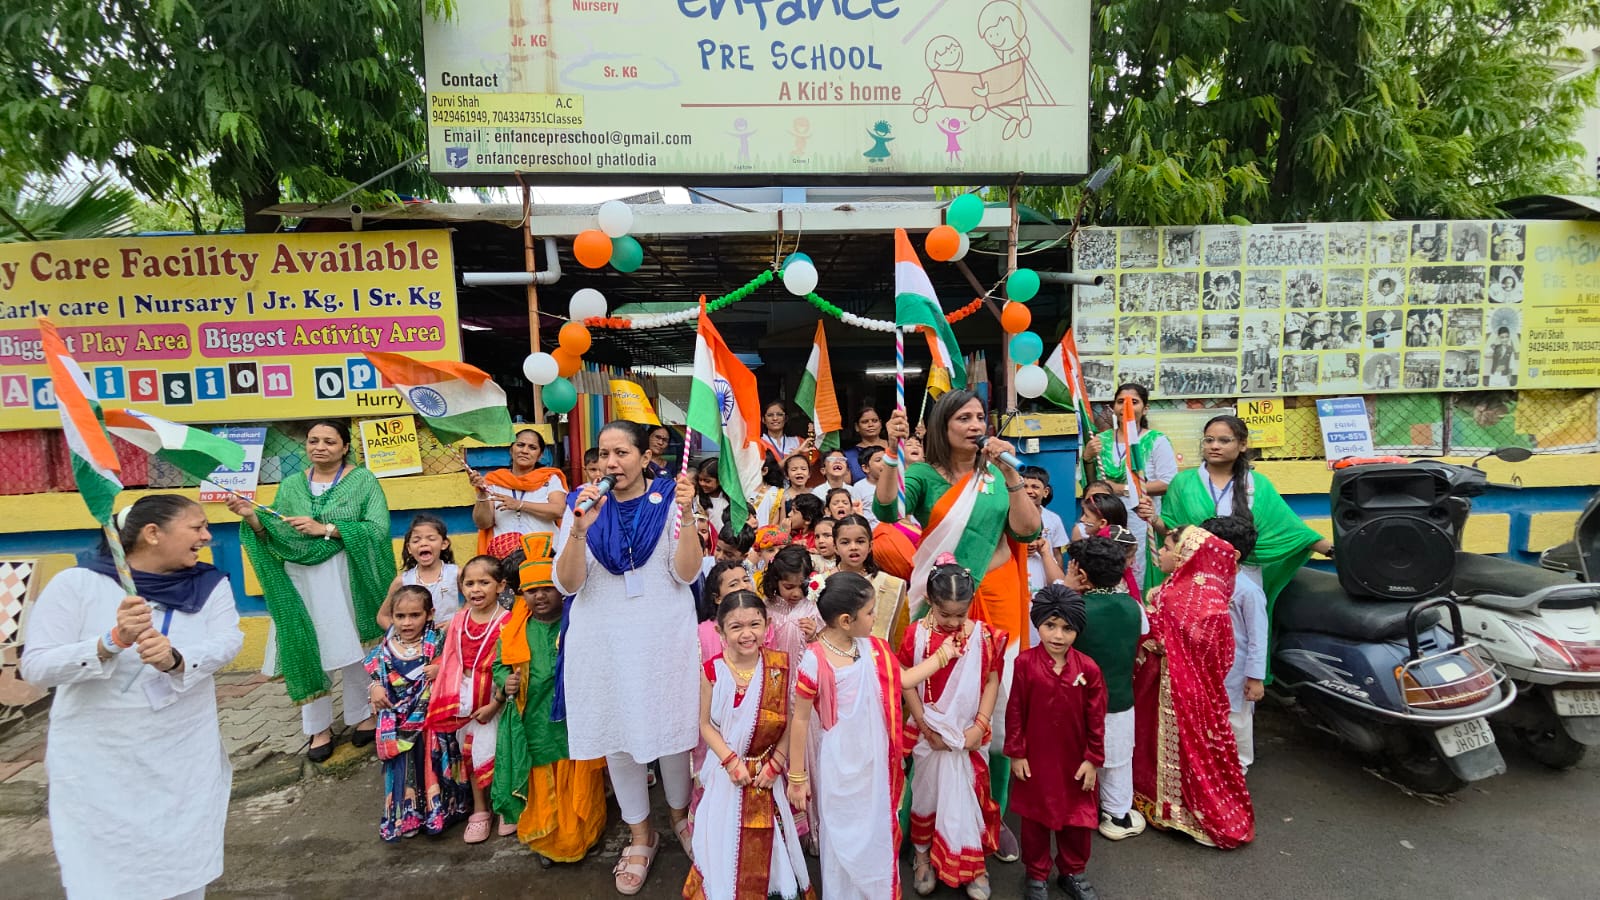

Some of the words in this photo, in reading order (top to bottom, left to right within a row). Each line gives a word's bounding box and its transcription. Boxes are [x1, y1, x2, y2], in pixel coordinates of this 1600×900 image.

[572, 0, 619, 15] Nursery
[511, 34, 526, 47] Jr.
[530, 34, 547, 47] KG
[697, 39, 754, 71] PRE
[771, 40, 882, 71] SCHOOL
[441, 71, 498, 88] Contact
[603, 65, 619, 78] Sr.
[622, 65, 638, 78] KG
[778, 81, 791, 101] A
[798, 80, 843, 101] Kid's
[850, 81, 901, 101] home
[431, 95, 456, 108] Purvi
[457, 94, 480, 108] Shah
[555, 98, 573, 109] A.C
[547, 113, 582, 124] Classes
[444, 129, 481, 143] Email
[494, 130, 693, 146] enfancepreschool@gmail.com
[476, 152, 592, 167] enfancepreschool
[596, 152, 657, 168] ghatlodia
[30, 251, 110, 282] Care
[119, 246, 259, 282] Facility
[270, 241, 439, 274] Available
[59, 301, 109, 317] care
[134, 294, 238, 315] Nursary
[263, 291, 296, 310] Jr.
[303, 289, 344, 313] Kg.
[369, 288, 402, 307] Sr.
[408, 286, 442, 310] Kg
[80, 331, 129, 357] Play
[135, 329, 189, 352] Area
[204, 328, 287, 353] Biggest
[292, 324, 383, 347] Activity
[389, 322, 441, 344] Area
[1241, 379, 1250, 393] 2
[1257, 373, 1265, 388] 1
[367, 433, 416, 448] PARKING
